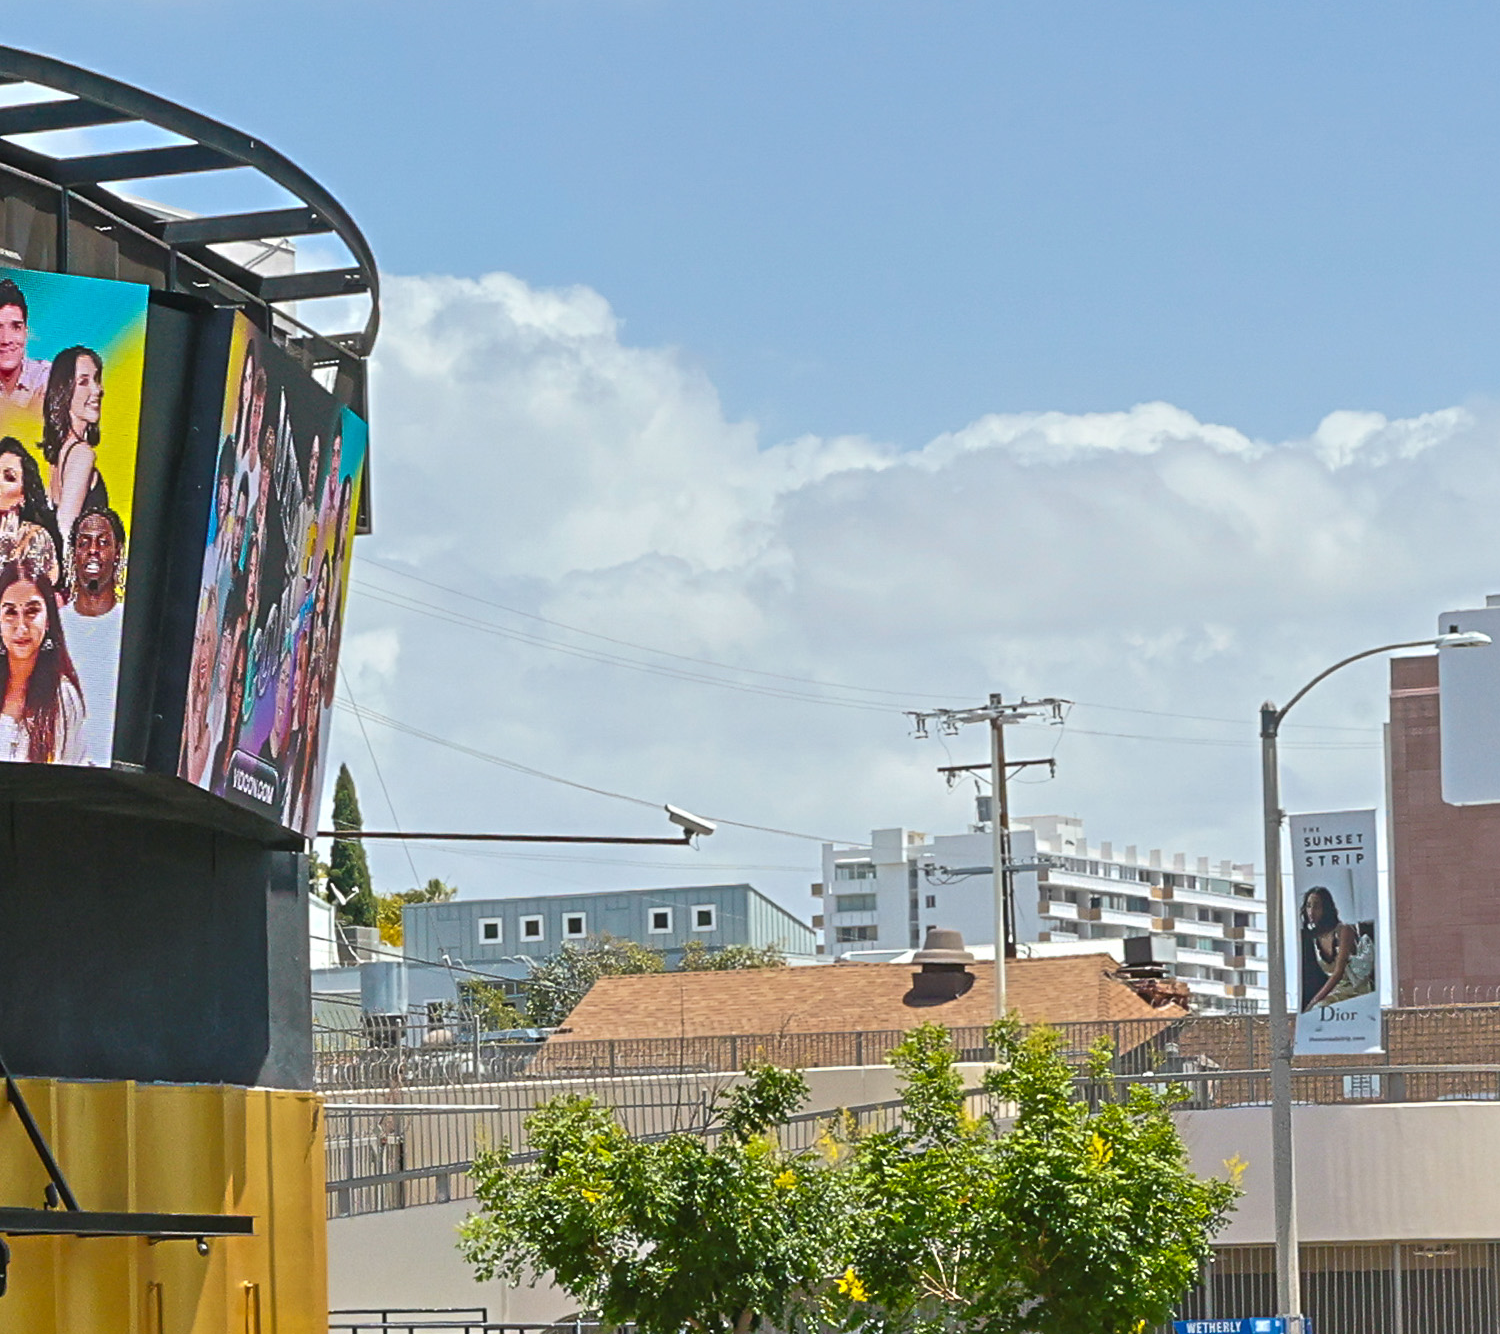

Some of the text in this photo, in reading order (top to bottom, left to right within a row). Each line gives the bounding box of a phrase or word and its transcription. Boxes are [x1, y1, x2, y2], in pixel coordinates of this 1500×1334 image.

[1304, 834, 1363, 847] SUNSET
[1306, 854, 1364, 867] STRIP
[1320, 1006, 1358, 1021] Dior
[1186, 1321, 1242, 1334] WETHERLY
